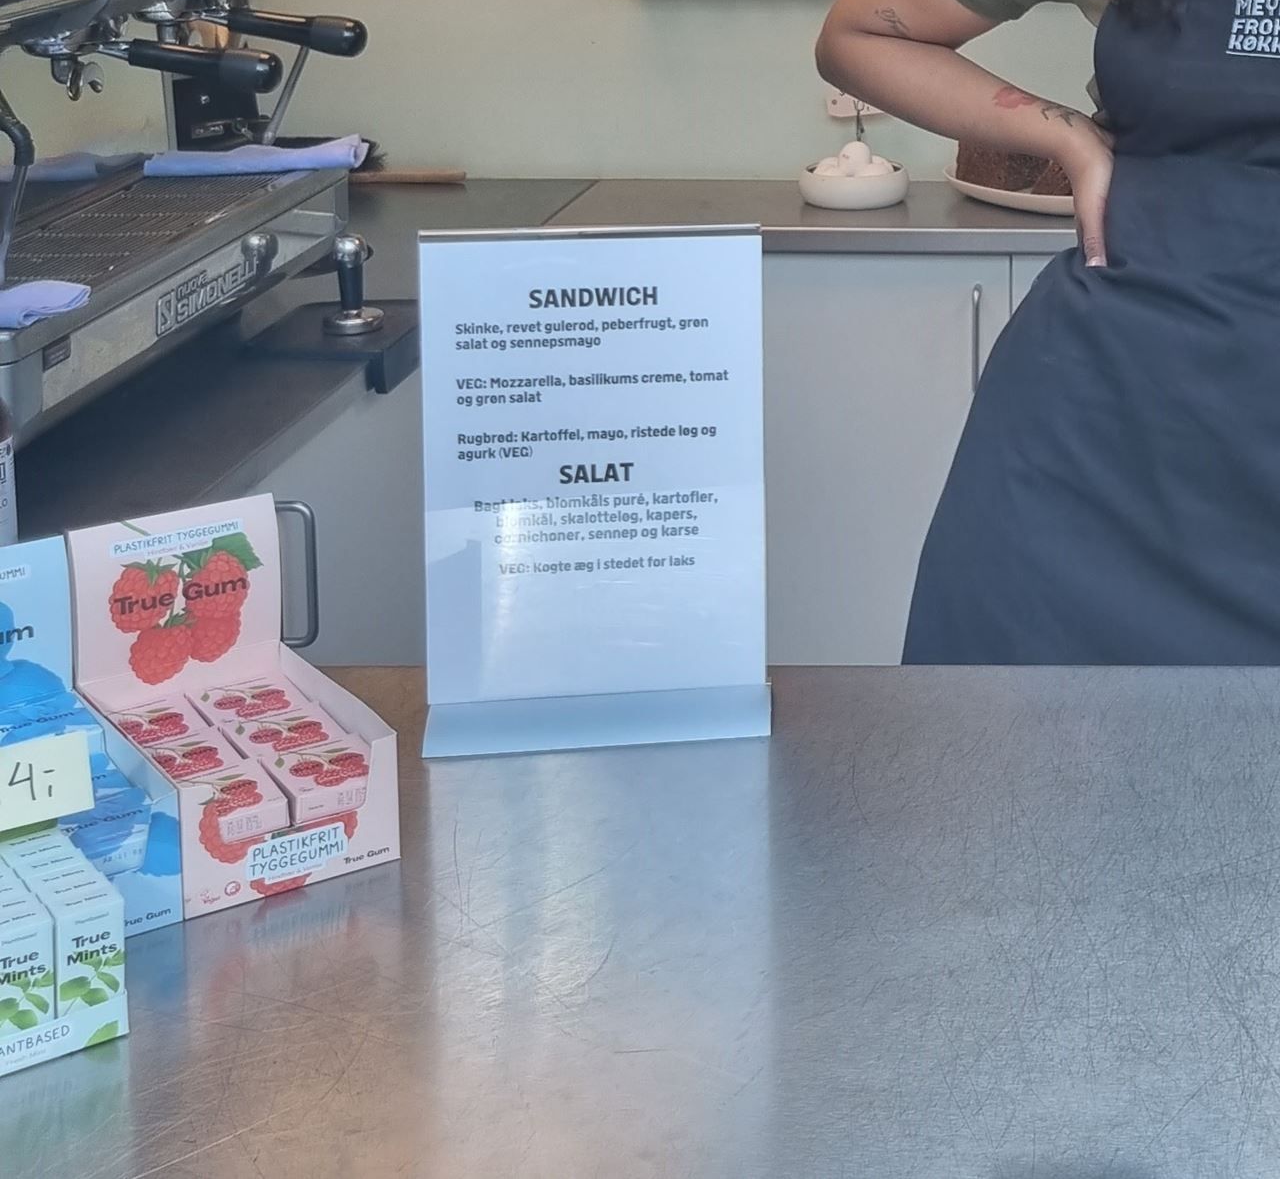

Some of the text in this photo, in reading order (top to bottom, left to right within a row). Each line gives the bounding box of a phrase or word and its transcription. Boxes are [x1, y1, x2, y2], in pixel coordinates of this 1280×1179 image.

[528, 286, 659, 309] SANDWICH
[456, 316, 709, 336] Skinke, revet gulerod, peberfrugt, grøn
[456, 336, 601, 351] salat og sennepsmayo
[456, 370, 729, 390] VEG: Mozzarella, basilikums creme, tomat
[457, 392, 542, 406] og grøn salat
[457, 425, 717, 446] Rugbrød: Kartoffel, mayo, ristede løg og
[457, 446, 533, 462] agurk (VEG)
[559, 462, 634, 485] SALAT
[613, 493, 649, 507] puré,
[652, 490, 719, 505] kartofler,
[560, 510, 643, 525] skalotteløg,
[646, 508, 698, 522] kapers,
[114, 533, 174, 555] PLASTIKFRIT
[177, 521, 239, 542] TYGGEGUMMI
[588, 527, 638, 541] sennep
[641, 527, 658, 539] og
[661, 524, 700, 537] karse
[533, 560, 572, 574] Kogte
[574, 560, 594, 572] æg
[597, 559, 601, 570] i
[603, 557, 645, 570] stedet
[647, 556, 666, 568] for
[668, 554, 696, 566] laks
[114, 576, 248, 616] True Gum
[252, 826, 340, 862] PLASTIKFRIT
[250, 840, 344, 877] TYGGEGUMMI
[343, 846, 391, 865] True Gum
[146, 908, 172, 920] Gum
[72, 930, 111, 949] True
[0, 951, 40, 970] True
[67, 942, 118, 967] Mints
